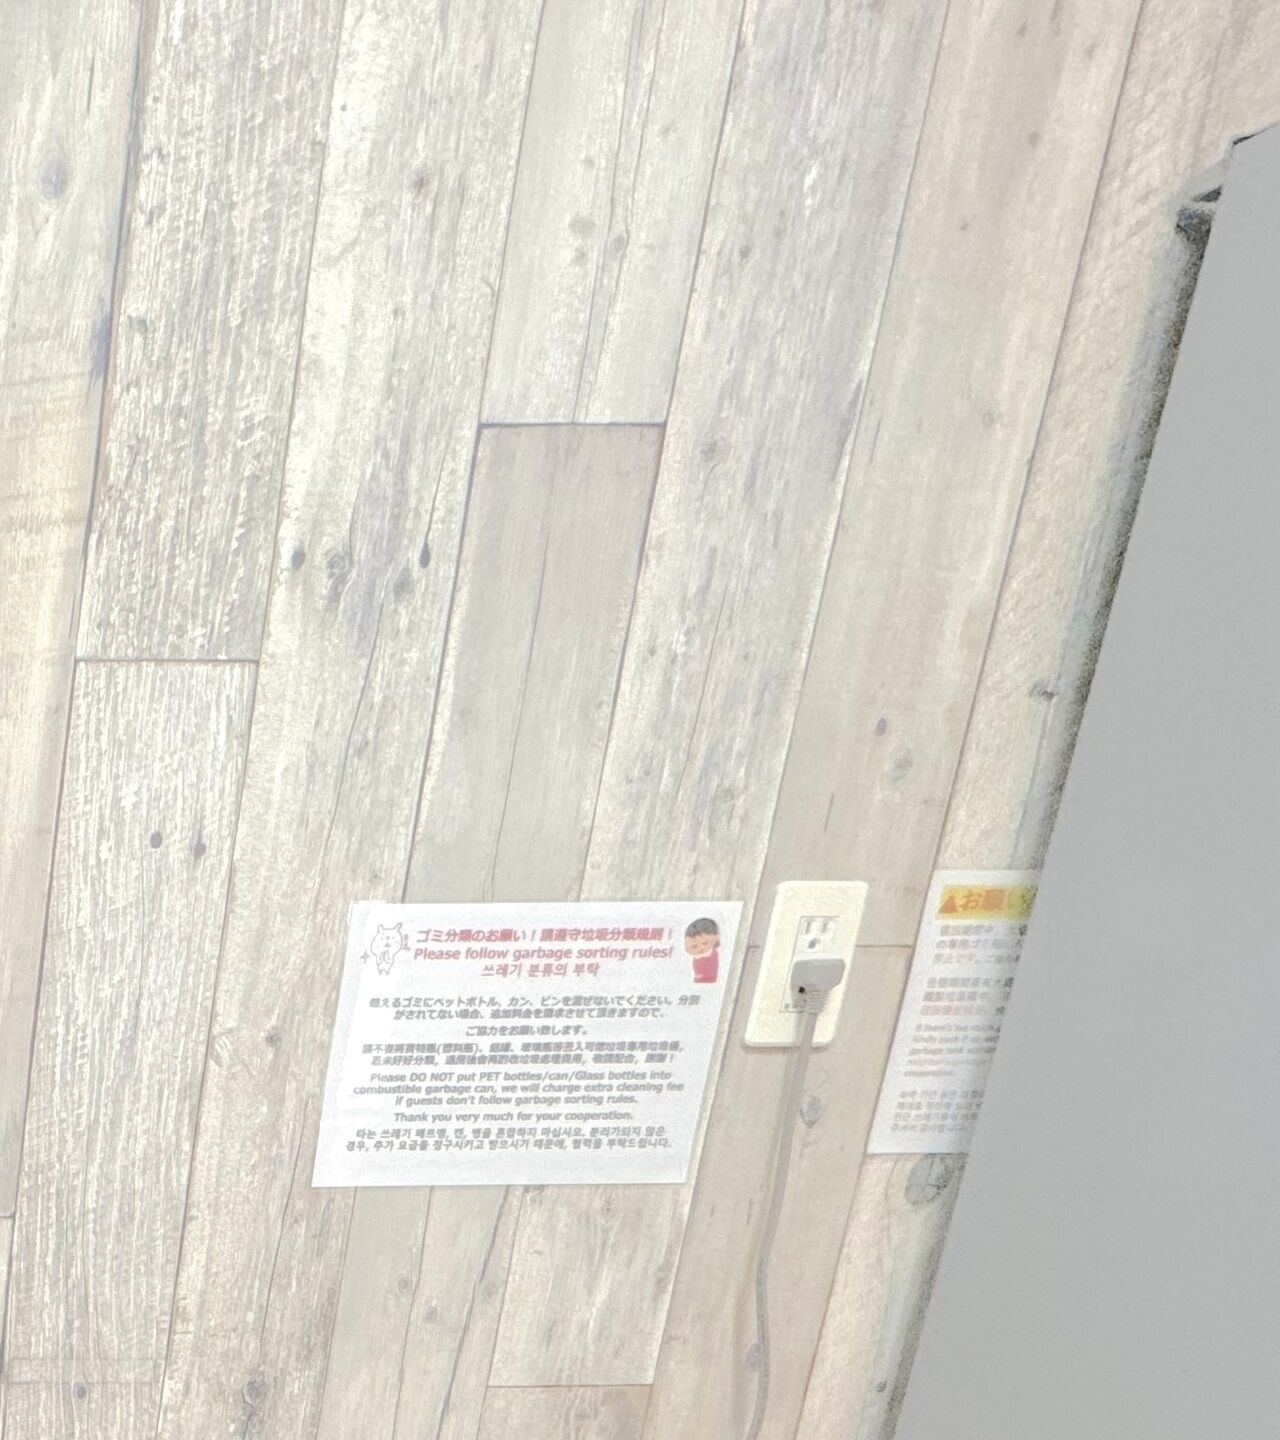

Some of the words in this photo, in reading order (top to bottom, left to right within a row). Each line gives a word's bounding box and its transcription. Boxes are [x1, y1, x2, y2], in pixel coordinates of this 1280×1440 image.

[414, 947, 461, 960] Please
[465, 946, 510, 960] follow
[511, 946, 573, 962] garbage
[576, 946, 629, 961] sorting
[632, 945, 674, 959] rules!
[481, 963, 523, 978] 쓰레기
[528, 962, 568, 977] 분류의
[572, 962, 600, 977] 부탁
[370, 1072, 407, 1082] Please
[409, 1072, 427, 1082] DO
[430, 1072, 454, 1082] NOT
[456, 1072, 476, 1084] put
[479, 1071, 502, 1082] PET
[503, 1070, 605, 1082] bottles/can/Glass
[608, 1070, 646, 1081] bottles
[650, 1070, 672, 1080] into
[353, 1084, 422, 1095] combustible
[424, 1084, 471, 1095] garbage
[474, 1085, 498, 1095] can,
[501, 1085, 518, 1093] we
[520, 1082, 540, 1093] will
[542, 1082, 581, 1094] charge
[584, 1083, 613, 1093] extra
[616, 1082, 663, 1094] cleaning
[666, 1081, 685, 1092] fee
[406, 1097, 443, 1108] guests
[478, 1095, 513, 1105] follow
[514, 1095, 562, 1107] garbage
[564, 1095, 604, 1106] sorting
[606, 1095, 639, 1105] rules.
[394, 1112, 428, 1122] Thank
[431, 1114, 452, 1124] you
[455, 1113, 480, 1123] very
[482, 1111, 514, 1121] much
[517, 1111, 534, 1121] for
[536, 1112, 562, 1123] your
[564, 1110, 634, 1122] cooperation.
[380, 1127, 412, 1140] 쓰레기
